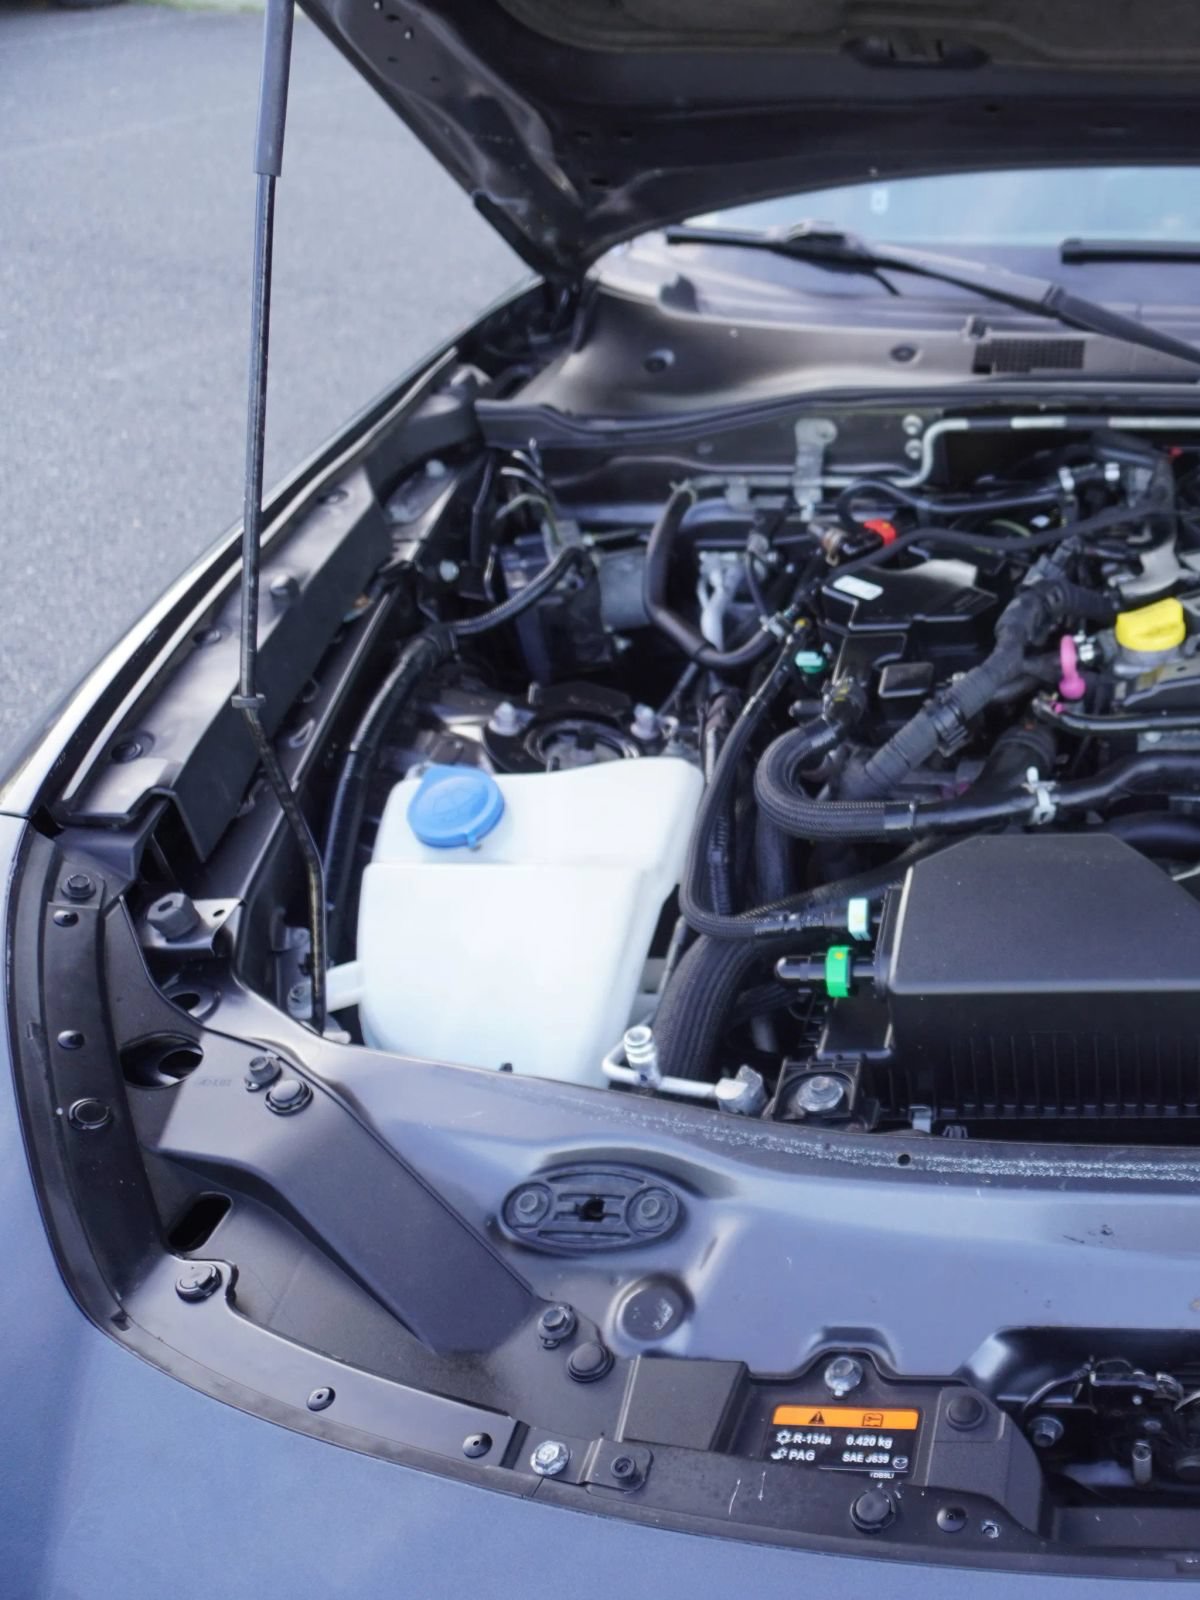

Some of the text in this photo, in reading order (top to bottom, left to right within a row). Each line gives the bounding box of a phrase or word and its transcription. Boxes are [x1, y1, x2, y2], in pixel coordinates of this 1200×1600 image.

[793, 1434, 893, 1449] R-134a 0.420 kg
[788, 1449, 890, 1464] PAG SAE J639
